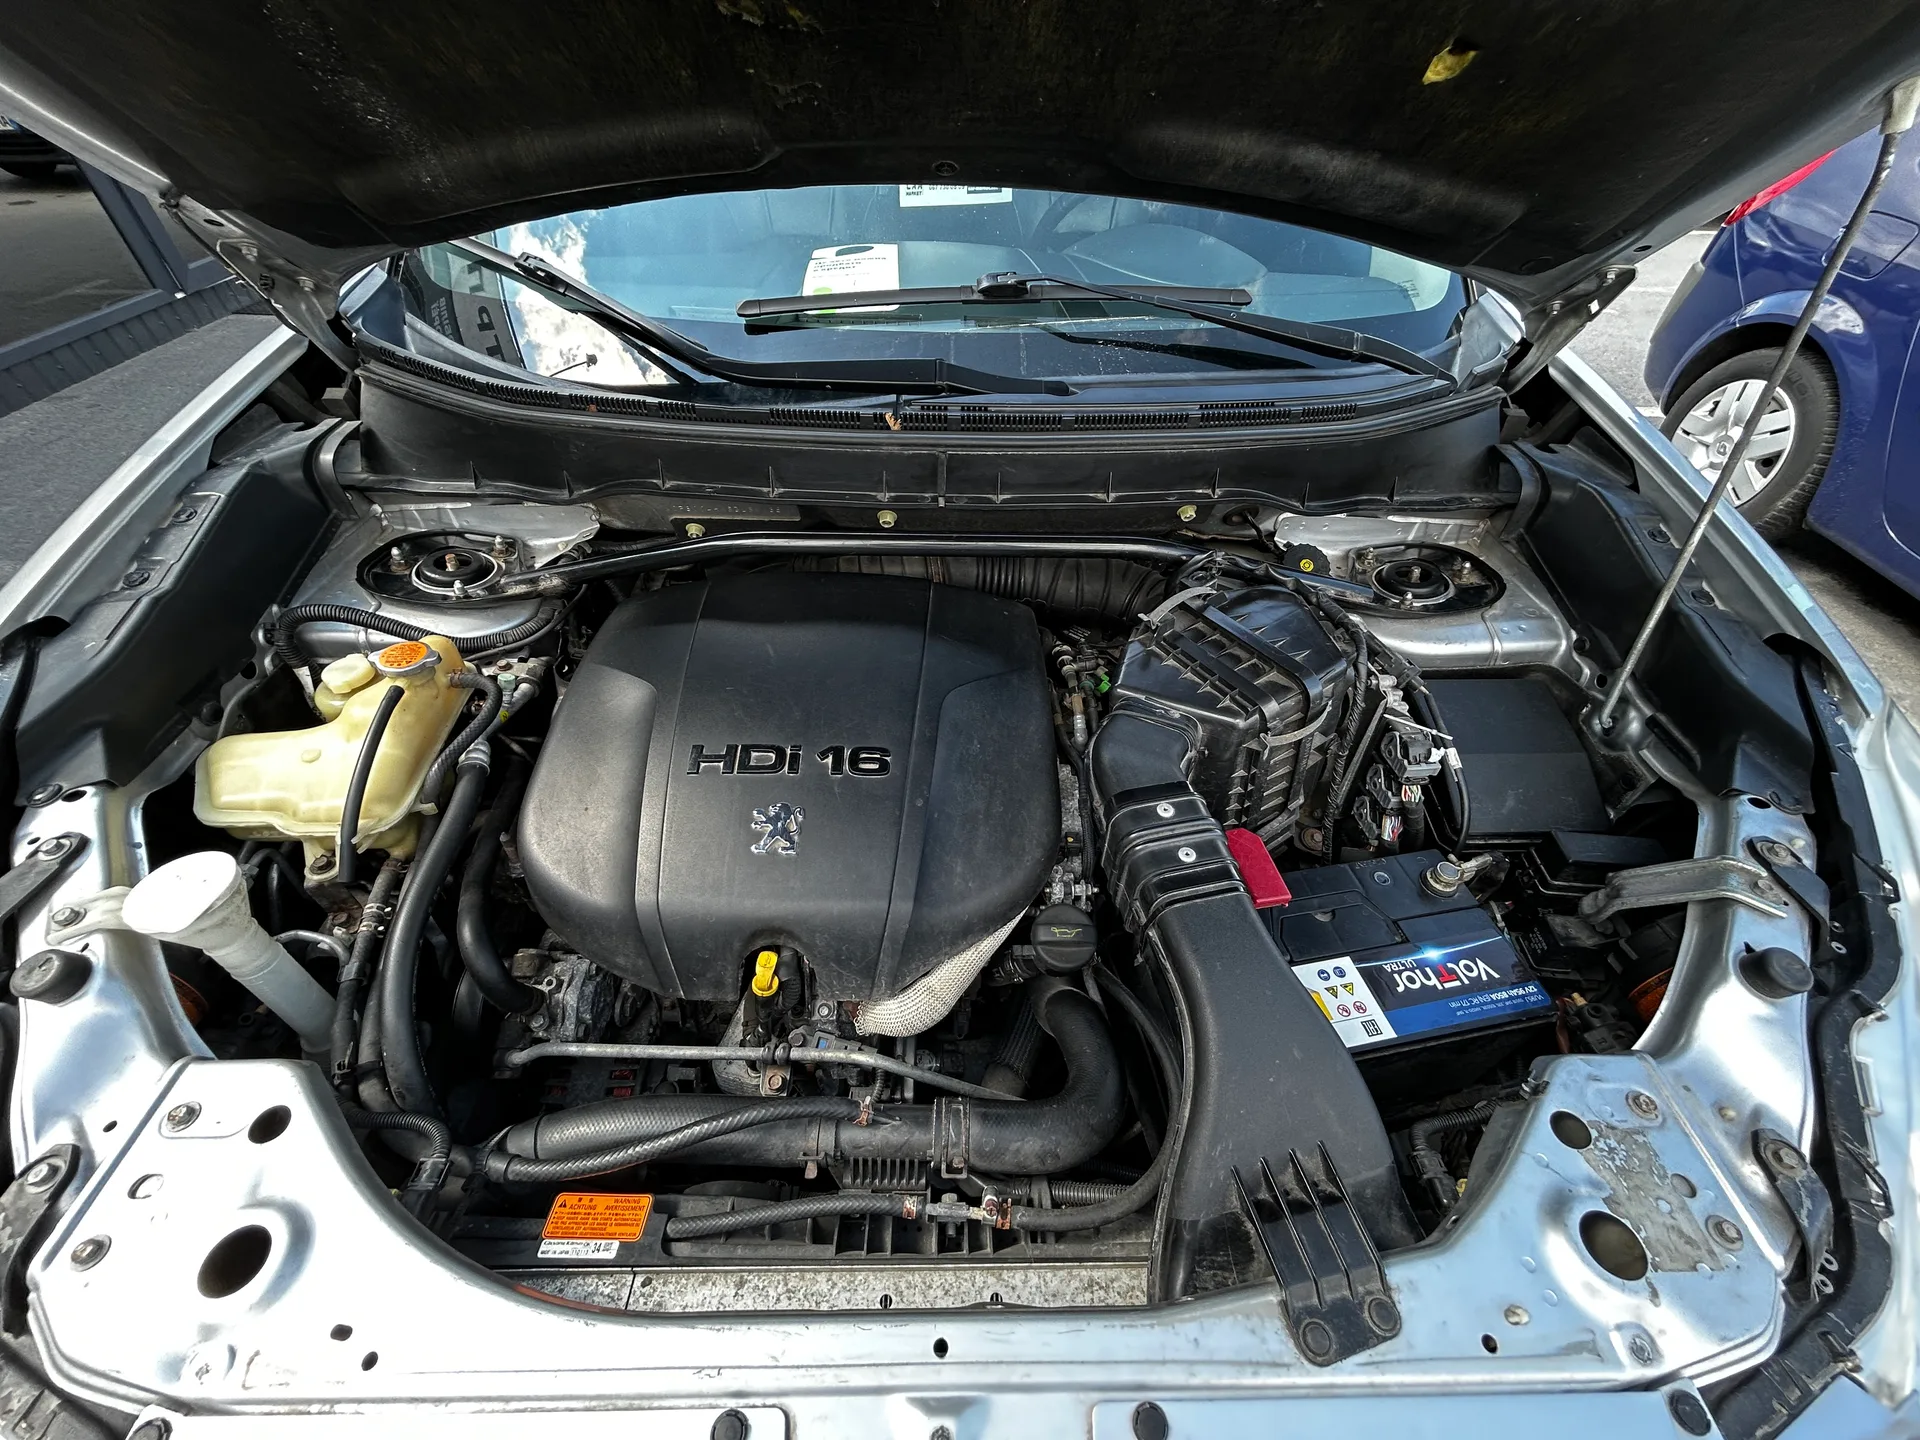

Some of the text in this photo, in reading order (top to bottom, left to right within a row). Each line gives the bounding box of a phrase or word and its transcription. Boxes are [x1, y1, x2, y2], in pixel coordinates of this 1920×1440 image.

[686, 744, 892, 777] HDi 16
[1382, 958, 1417, 972] ULTRA
[1396, 957, 1501, 993] VolThor
[1525, 985, 1538, 994] 12V
